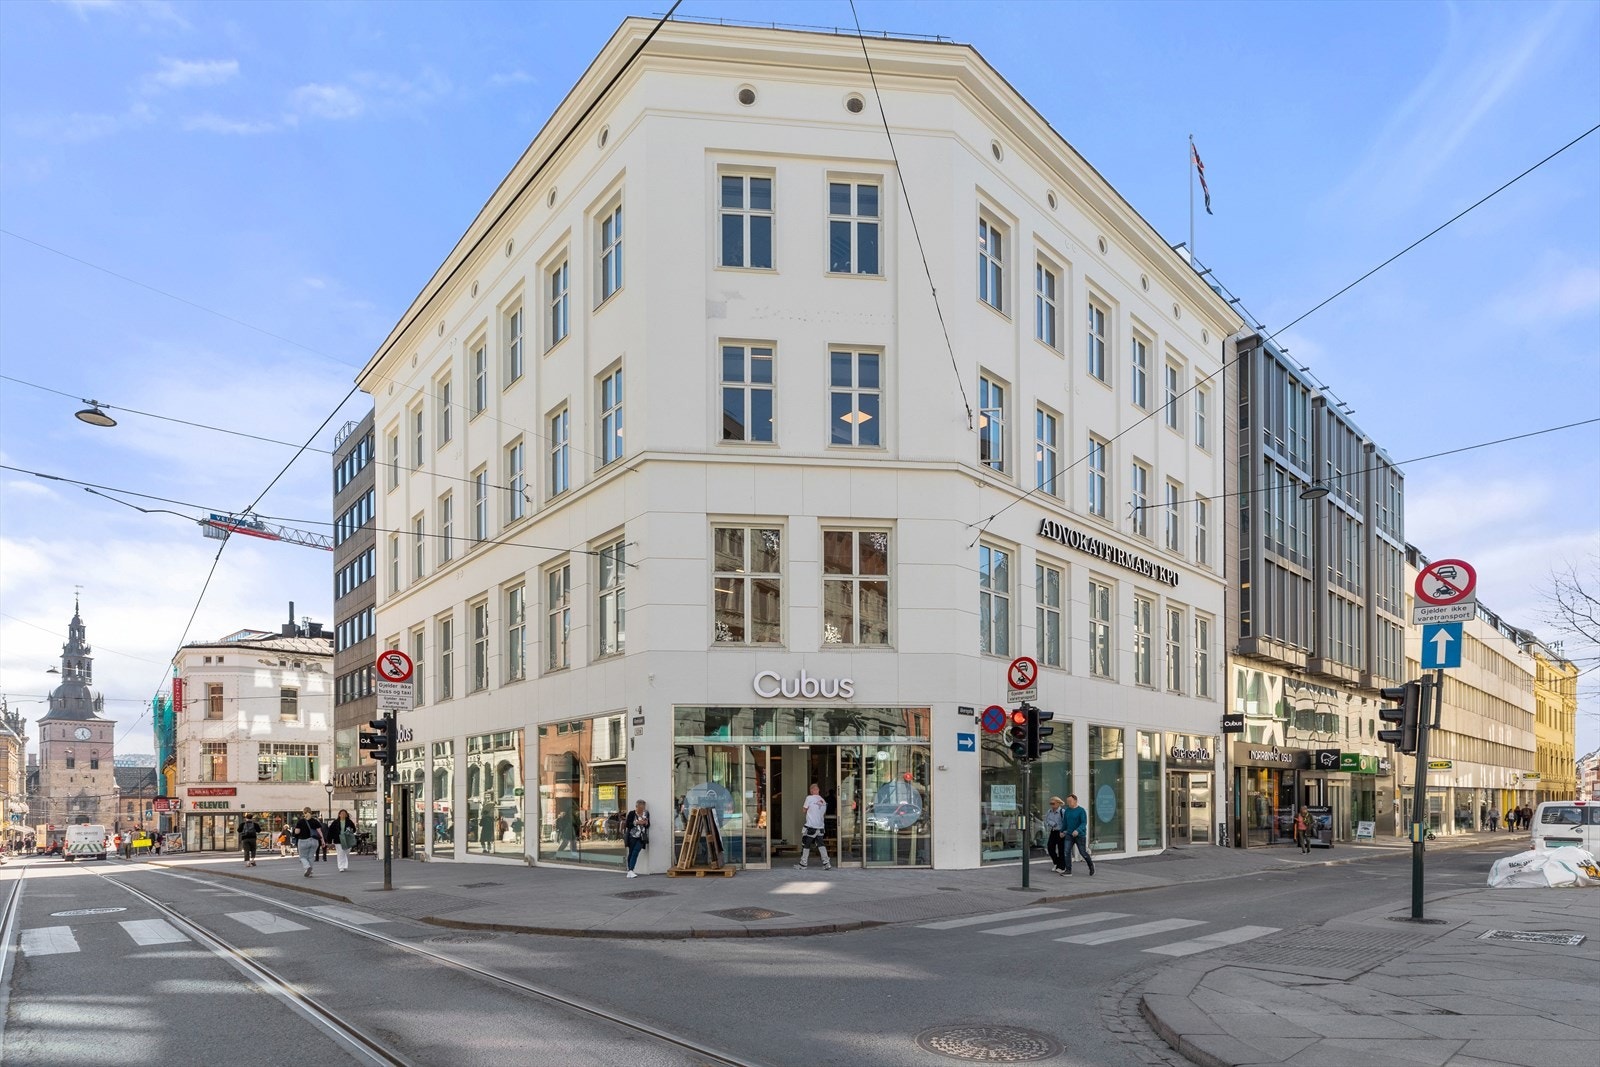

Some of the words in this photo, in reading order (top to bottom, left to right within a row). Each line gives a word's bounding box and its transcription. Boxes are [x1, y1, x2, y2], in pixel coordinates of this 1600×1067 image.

[1040, 518, 1157, 579] ADVOKATFIRMAET
[1157, 564, 1180, 587] KPU
[1418, 612, 1470, 622] varetransport
[753, 668, 856, 700] Cubus
